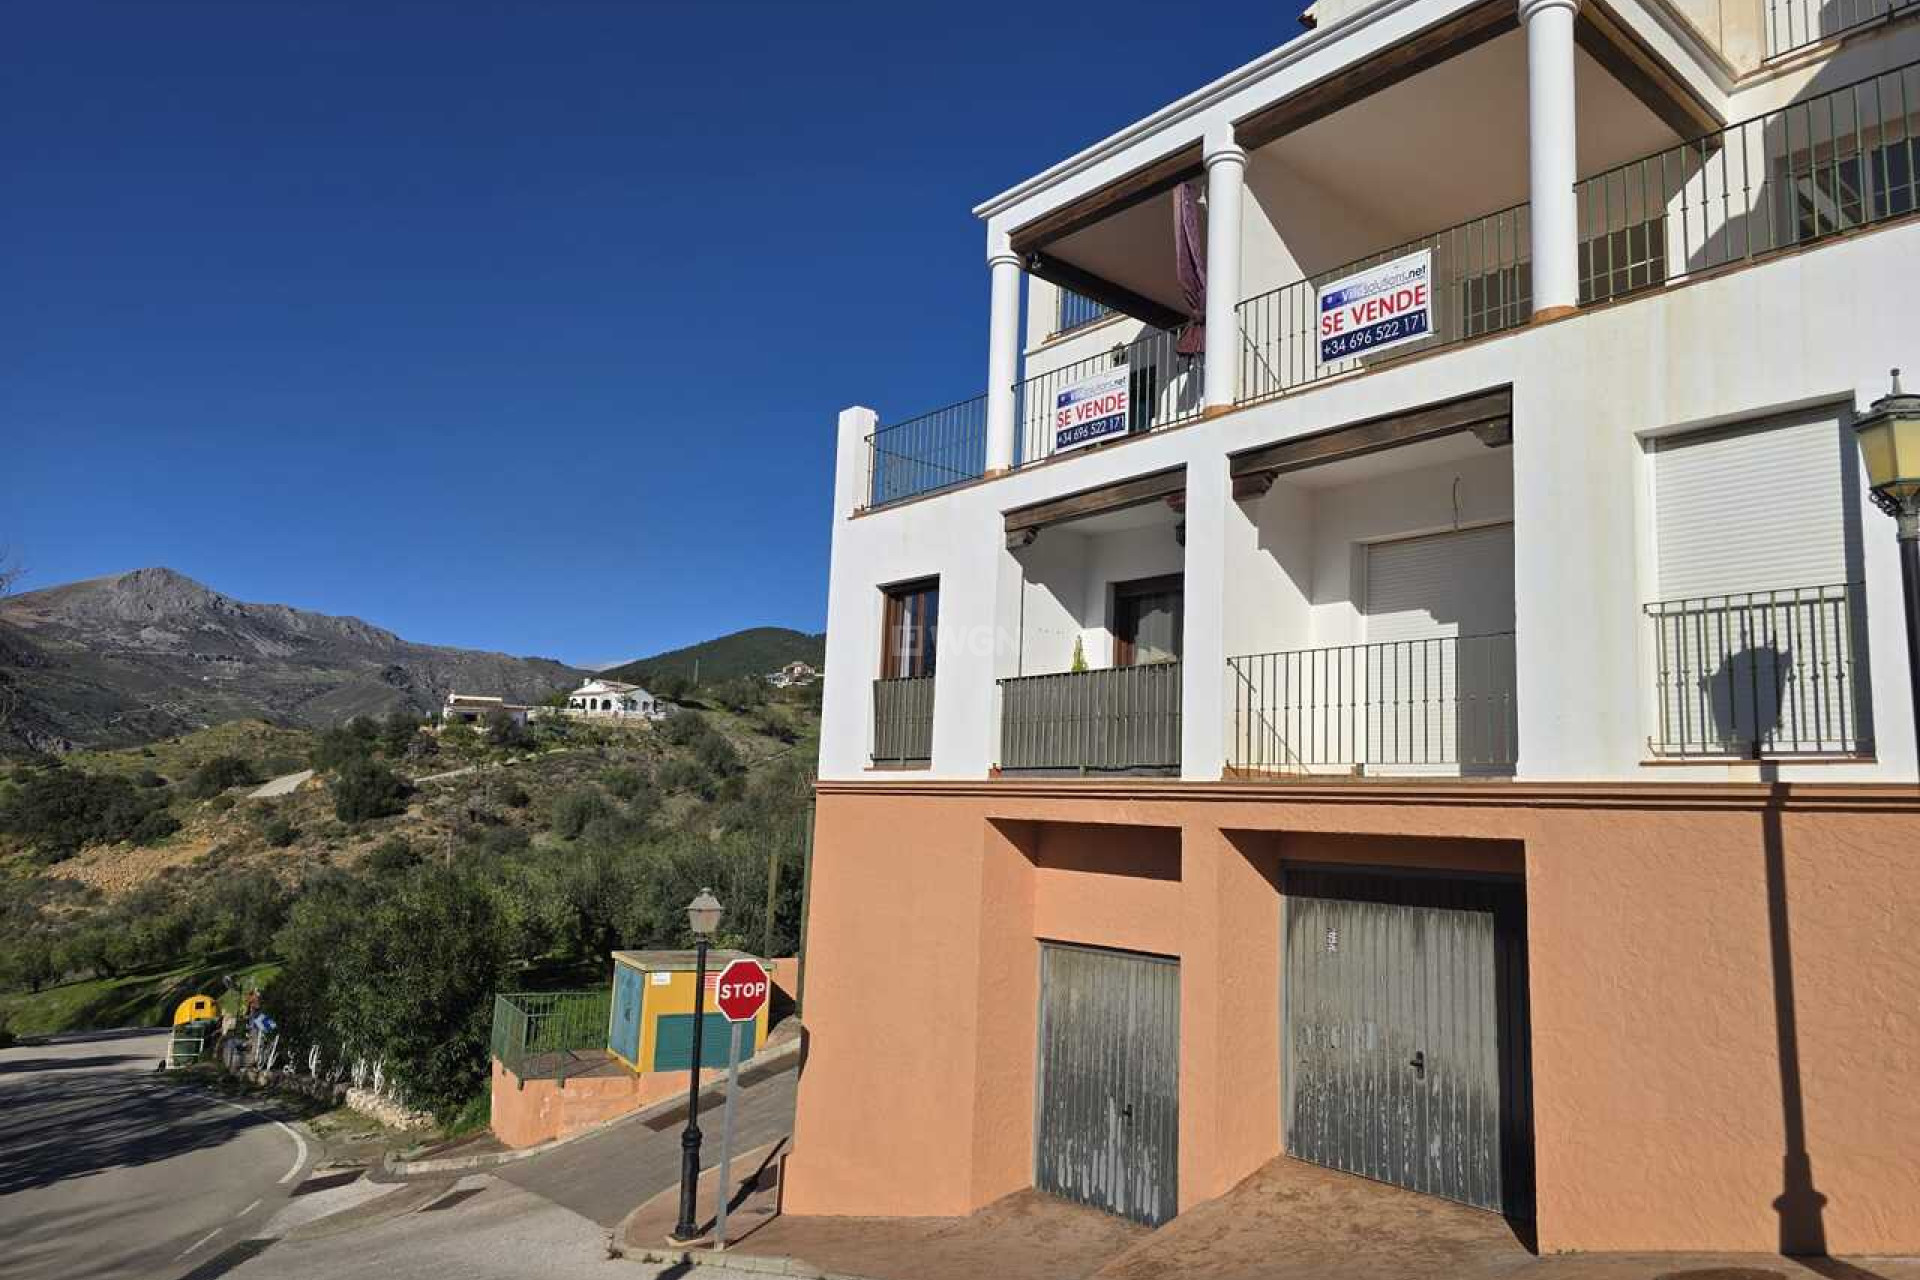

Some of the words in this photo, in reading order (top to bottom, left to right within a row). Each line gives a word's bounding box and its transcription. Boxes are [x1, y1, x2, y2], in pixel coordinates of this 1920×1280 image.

[1322, 312, 1344, 335] SE
[1351, 285, 1426, 325] VENDE
[1323, 338, 1346, 354] +34
[1350, 330, 1373, 349] 696
[1376, 322, 1399, 341] 522
[1404, 313, 1426, 332] 171
[1057, 409, 1072, 427] SE
[1076, 392, 1126, 421] VENDE
[1074, 425, 1089, 440] 696
[720, 982, 765, 999] STOP
